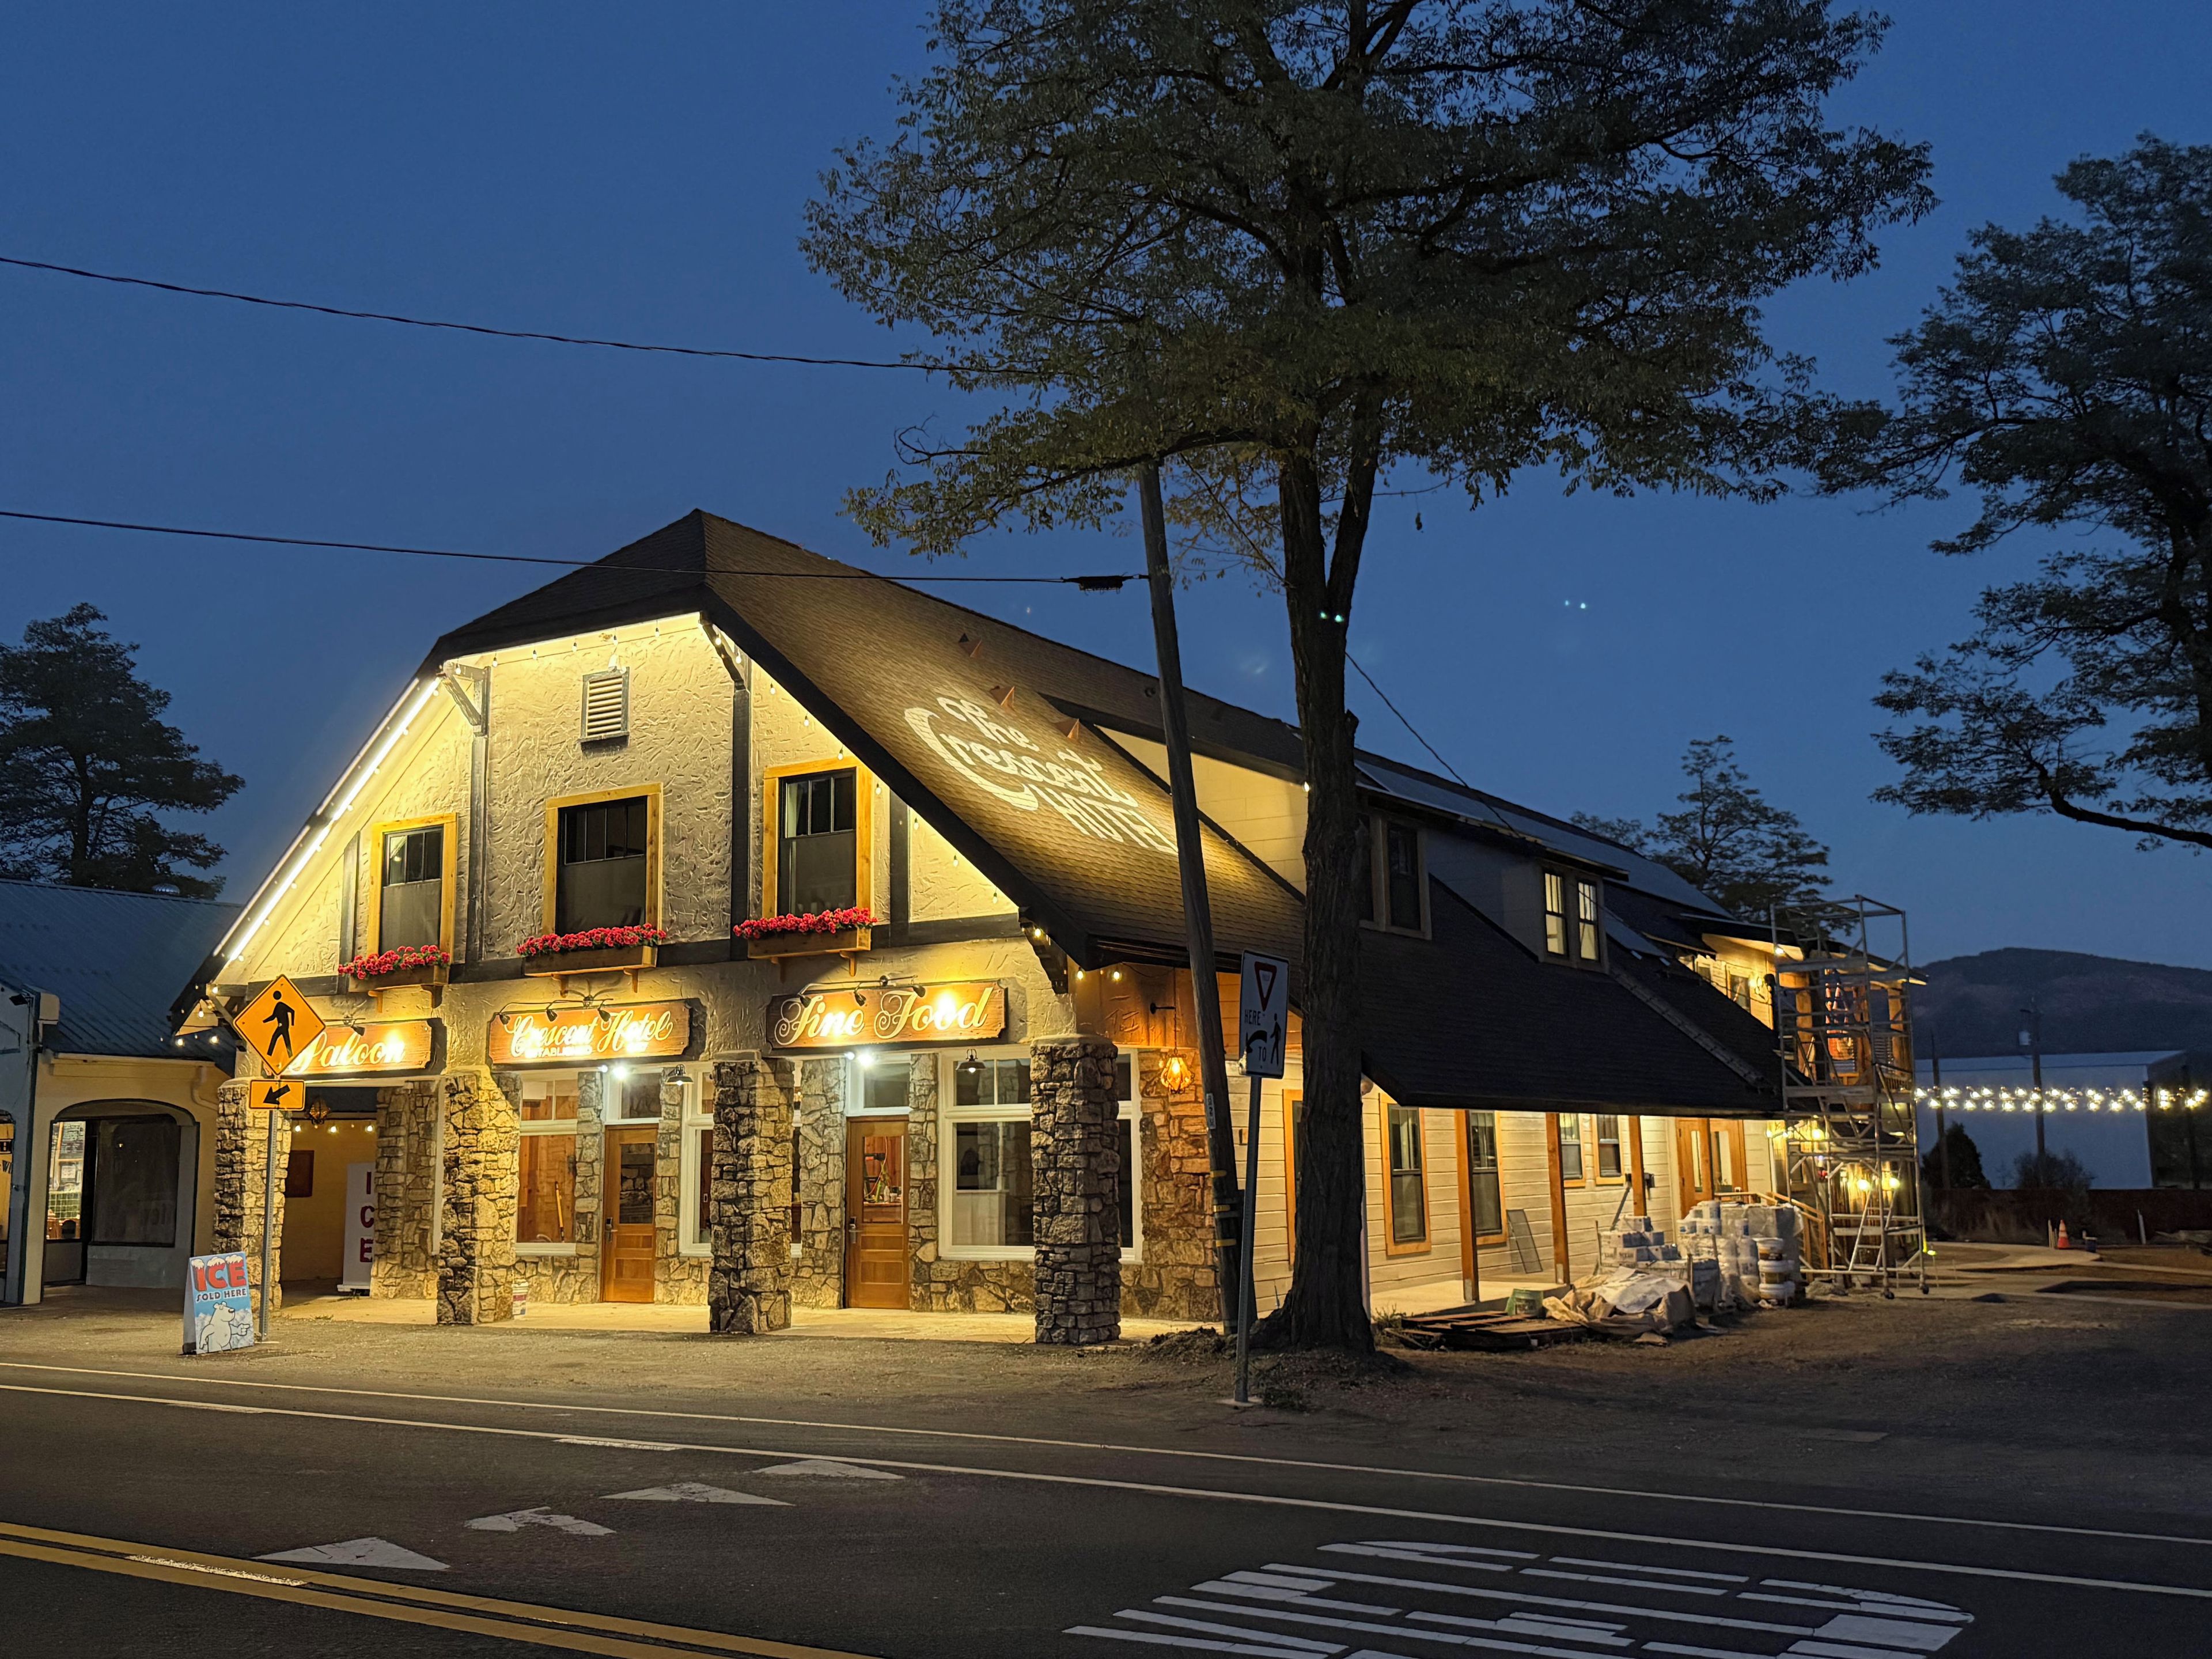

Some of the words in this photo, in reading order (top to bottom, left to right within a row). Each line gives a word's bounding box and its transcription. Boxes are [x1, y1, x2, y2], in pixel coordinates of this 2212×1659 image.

[937, 697, 1040, 752] The
[904, 707, 1138, 811] Crescent
[1027, 784, 1178, 855] HOTEL
[597, 1010, 673, 1052] Hotel
[774, 995, 865, 1046] Fine
[874, 987, 994, 1039] Food
[1244, 1009, 1262, 1026] HERE
[289, 1031, 406, 1074] Saloon
[1258, 1046, 1267, 1062] TO
[191, 1254, 247, 1292] ICE
[196, 1292, 221, 1302] SOLD
[224, 1289, 247, 1299] HERE
